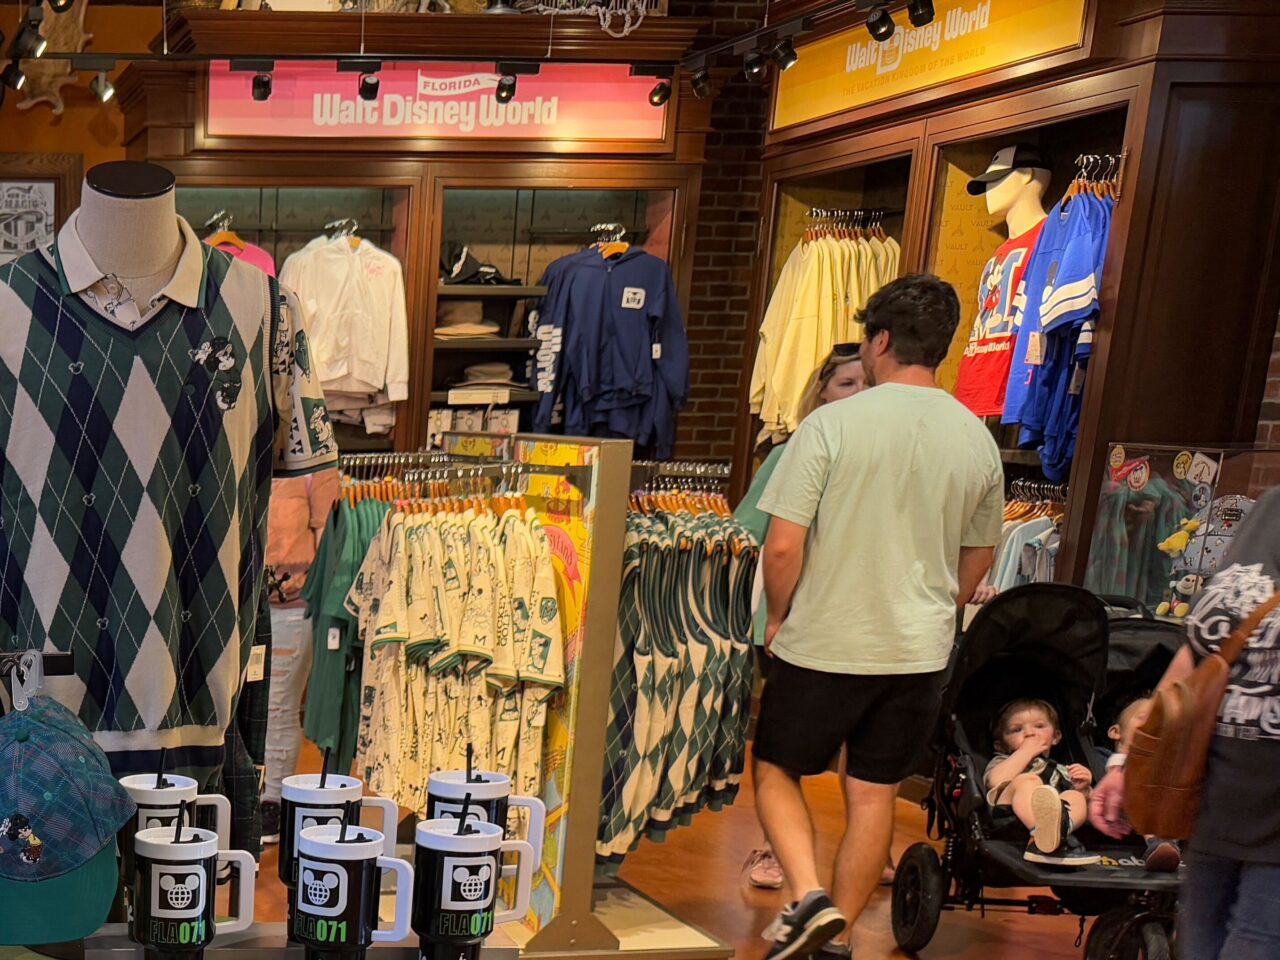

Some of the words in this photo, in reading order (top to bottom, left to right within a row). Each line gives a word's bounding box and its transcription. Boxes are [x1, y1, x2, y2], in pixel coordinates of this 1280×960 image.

[846, 40, 879, 73] Walt
[877, 21, 942, 75] Disney
[944, 2, 991, 41] World
[892, 65, 926, 82] KINGDOM
[928, 60, 938, 71] OF
[940, 55, 955, 67] THE
[957, 46, 986, 63] WORLD
[423, 77, 481, 91] FLORIDA
[312, 93, 379, 126] Walt
[382, 94, 476, 133] Disney
[479, 94, 559, 127] World
